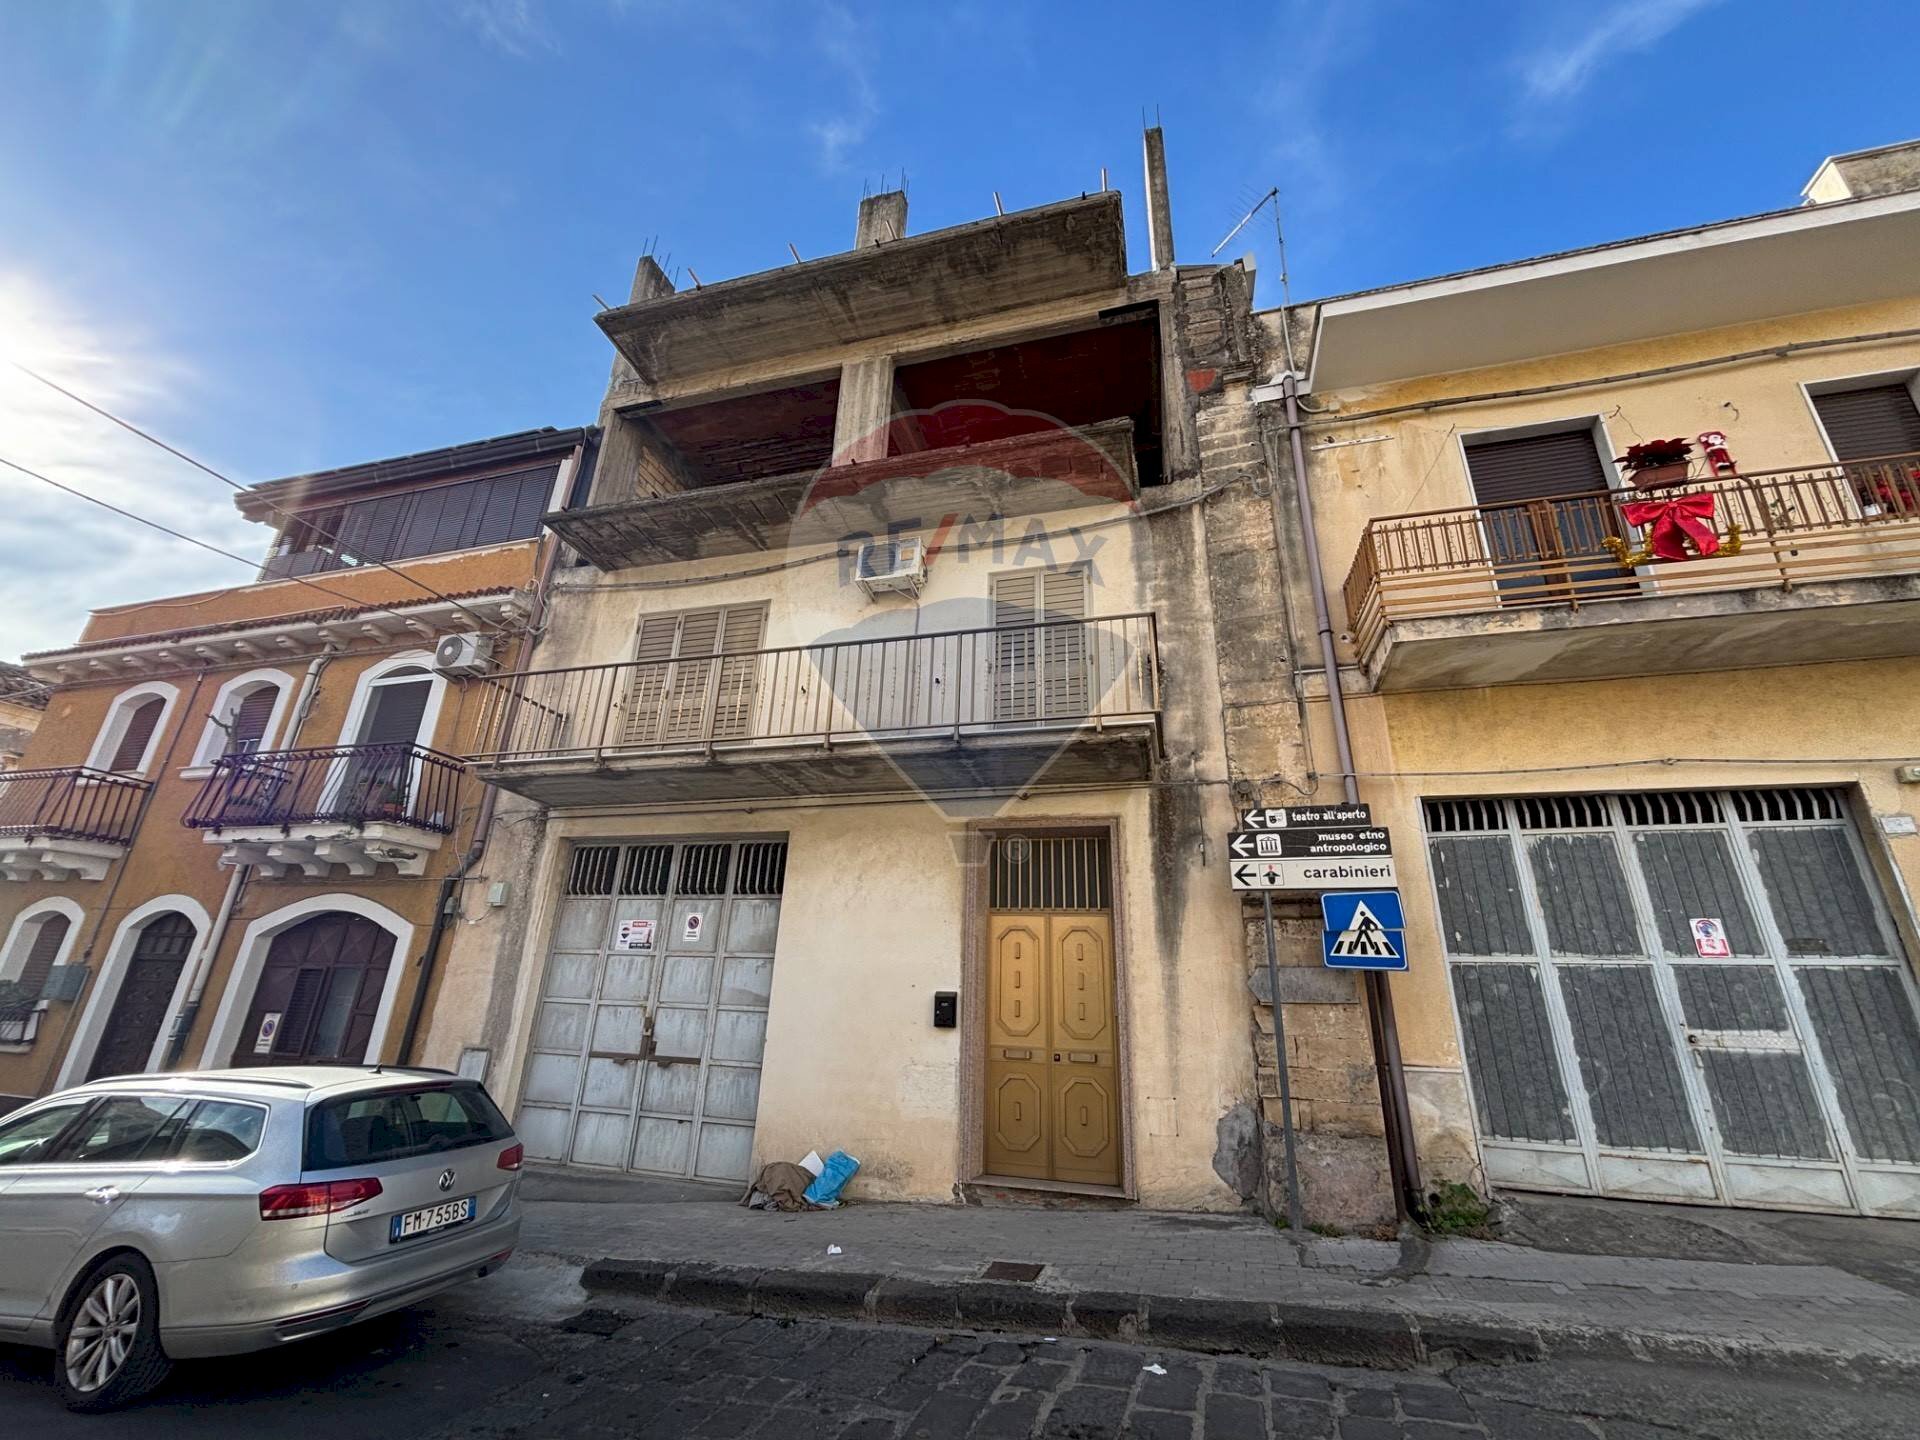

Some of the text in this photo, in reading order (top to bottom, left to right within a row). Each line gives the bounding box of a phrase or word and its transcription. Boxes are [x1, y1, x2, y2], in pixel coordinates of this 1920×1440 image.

[1291, 809, 1367, 822] teatro all'aperto
[1318, 831, 1385, 841] museo etno
[1310, 842, 1387, 853] antropologico
[1303, 864, 1391, 879] carabinieri
